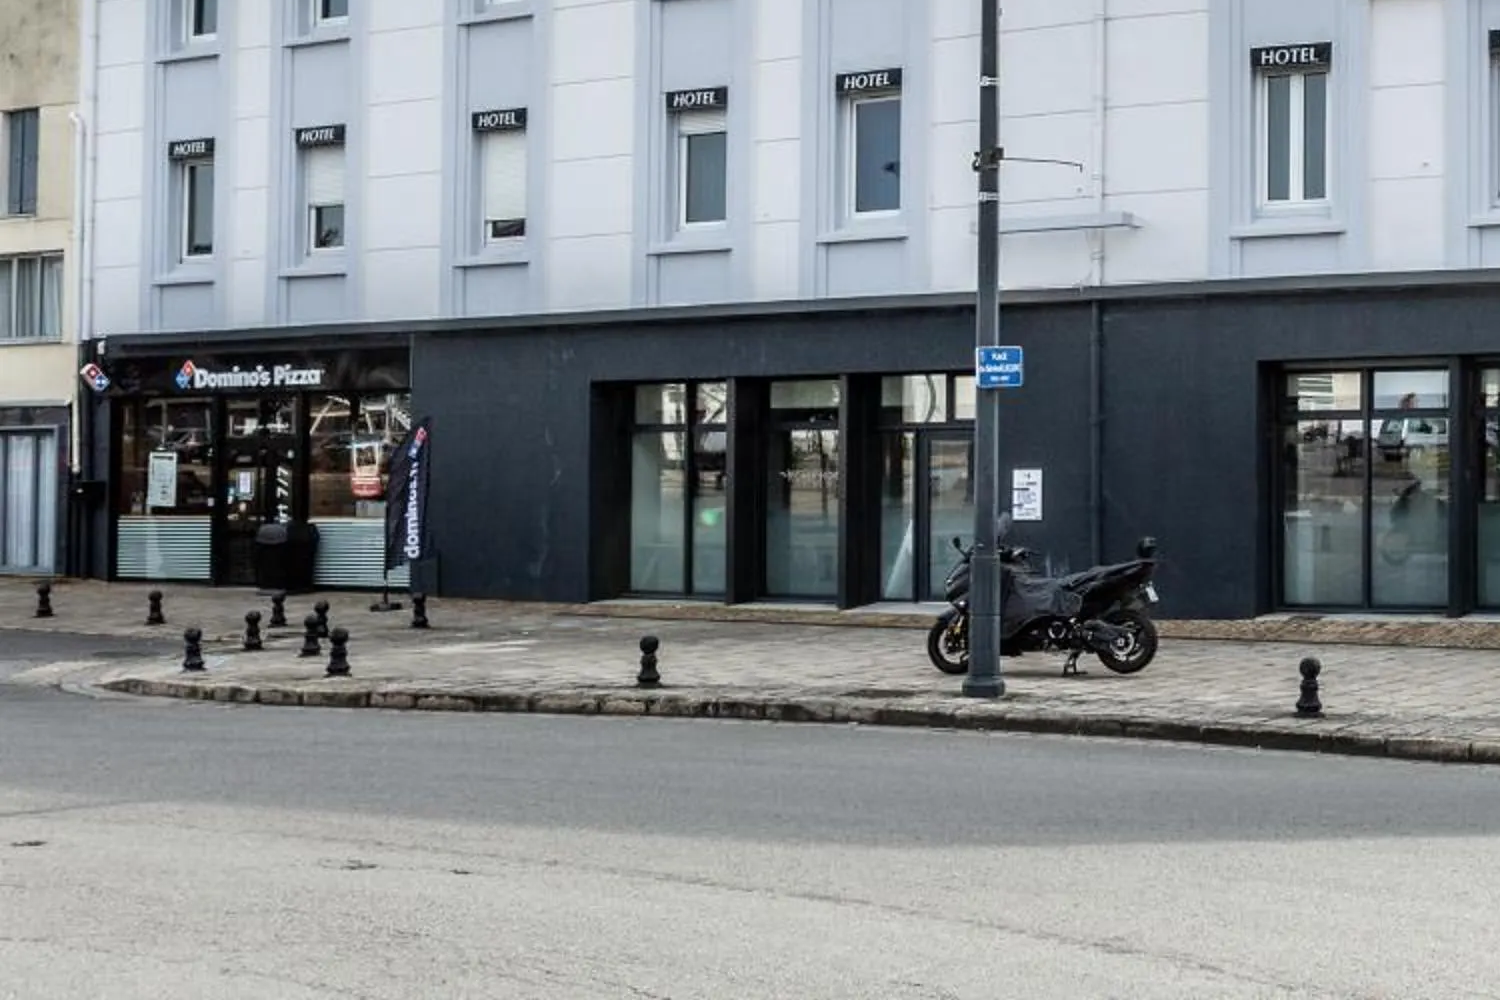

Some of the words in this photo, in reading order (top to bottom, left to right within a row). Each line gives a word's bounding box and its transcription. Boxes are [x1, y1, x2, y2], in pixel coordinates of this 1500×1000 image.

[1261, 47, 1318, 65] HOTEL
[843, 72, 890, 89] HOTEL
[673, 91, 715, 107] HOTEL
[478, 111, 517, 127] HOTEL
[300, 127, 334, 142] HOTEL
[173, 141, 206, 155] HOTEL
[193, 364, 271, 389] Domino's
[273, 363, 322, 386] Pizza
